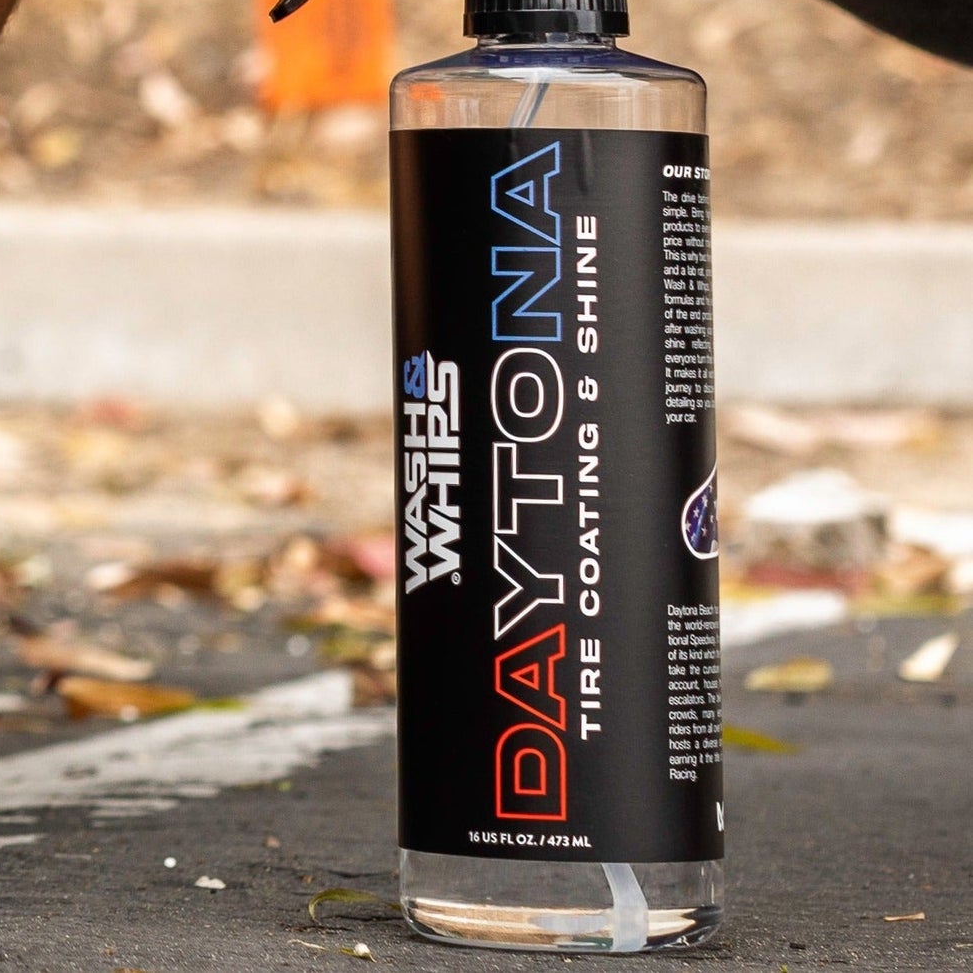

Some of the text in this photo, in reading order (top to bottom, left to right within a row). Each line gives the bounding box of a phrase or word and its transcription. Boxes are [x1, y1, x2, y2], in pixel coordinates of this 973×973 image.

[662, 165, 692, 178] OUR
[662, 190, 678, 203] The
[662, 206, 689, 219] simple.
[663, 221, 694, 234] products
[663, 235, 682, 248] price
[663, 249, 680, 261] This
[680, 250, 687, 261] is
[663, 264, 679, 275] and
[680, 267, 686, 276] a
[663, 279, 686, 290] Wash
[689, 280, 695, 291] &
[664, 293, 694, 305] formulas
[664, 308, 673, 319] of
[676, 308, 688, 320] the
[690, 310, 701, 320] end
[664, 323, 683, 334] after
[664, 338, 686, 349] shine
[665, 354, 697, 366] everyone
[665, 367, 672, 378] It
[674, 368, 697, 379] makes
[665, 382, 692, 395] journey
[665, 396, 696, 410] detailing
[665, 413, 697, 425] your car.
[491, 140, 567, 821] DAYTONA
[576, 215, 602, 741] TIRE COATING & SHINE
[667, 604, 698, 618] Daytona
[667, 620, 681, 631] the
[668, 635, 689, 646] tional
[668, 649, 677, 661] of
[678, 649, 688, 660] its
[689, 649, 703, 660] kind
[668, 664, 686, 675] take
[689, 664, 700, 675] the
[668, 694, 706, 705] escalators.
[668, 723, 691, 735] riders
[692, 723, 707, 734] from
[668, 738, 691, 750] hosts
[694, 740, 700, 749] a
[669, 753, 697, 767] earning
[669, 768, 699, 782] Racing.
[468, 831, 592, 848] 16 US FL OZ. / 473 ML
